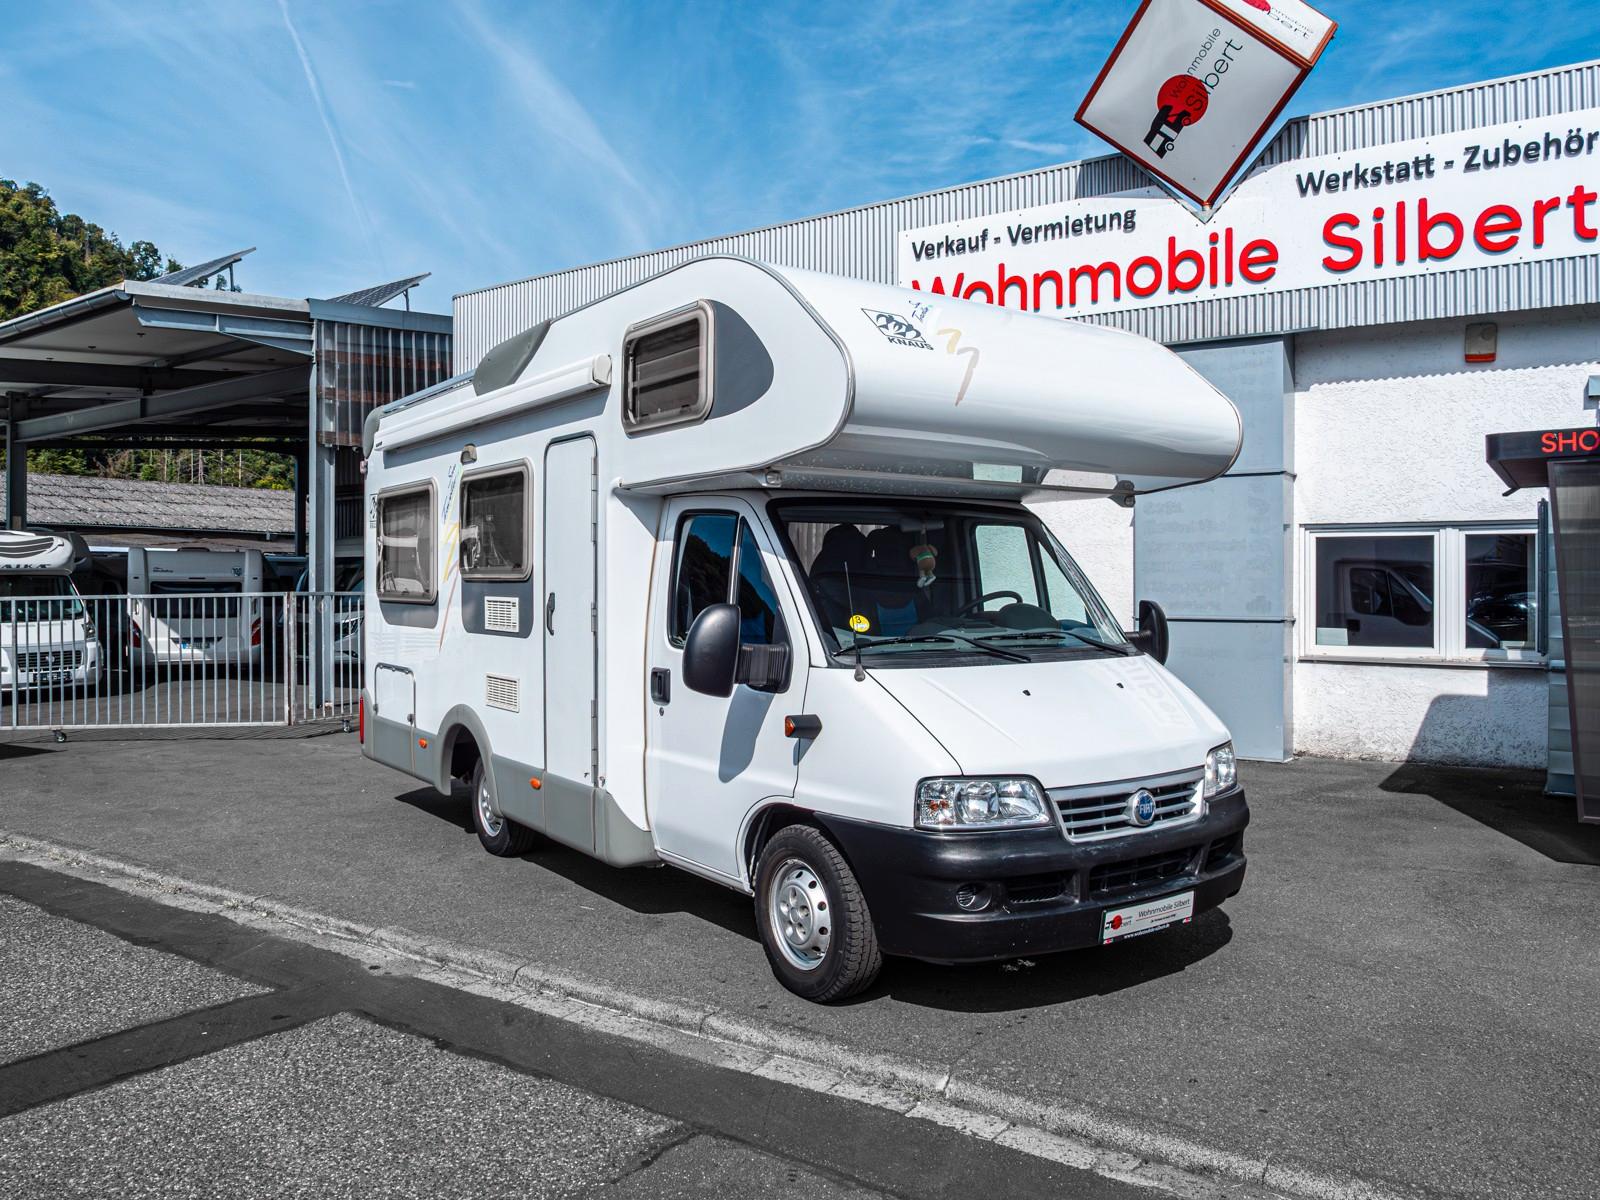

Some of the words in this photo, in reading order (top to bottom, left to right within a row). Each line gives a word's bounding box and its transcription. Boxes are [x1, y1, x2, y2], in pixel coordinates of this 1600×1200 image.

[1296, 153, 1434, 198] Werkstatt
[1463, 127, 1599, 172] Zubehör
[911, 230, 989, 263] Verkauf
[1007, 208, 1137, 247] Vermietung
[1322, 184, 1599, 272] Silbert
[888, 337, 934, 350] KNAUS
[1139, 803, 1153, 814] FIAT
[1138, 905, 1174, 918] Wohnmobile
[1173, 898, 1191, 909] Silbert
